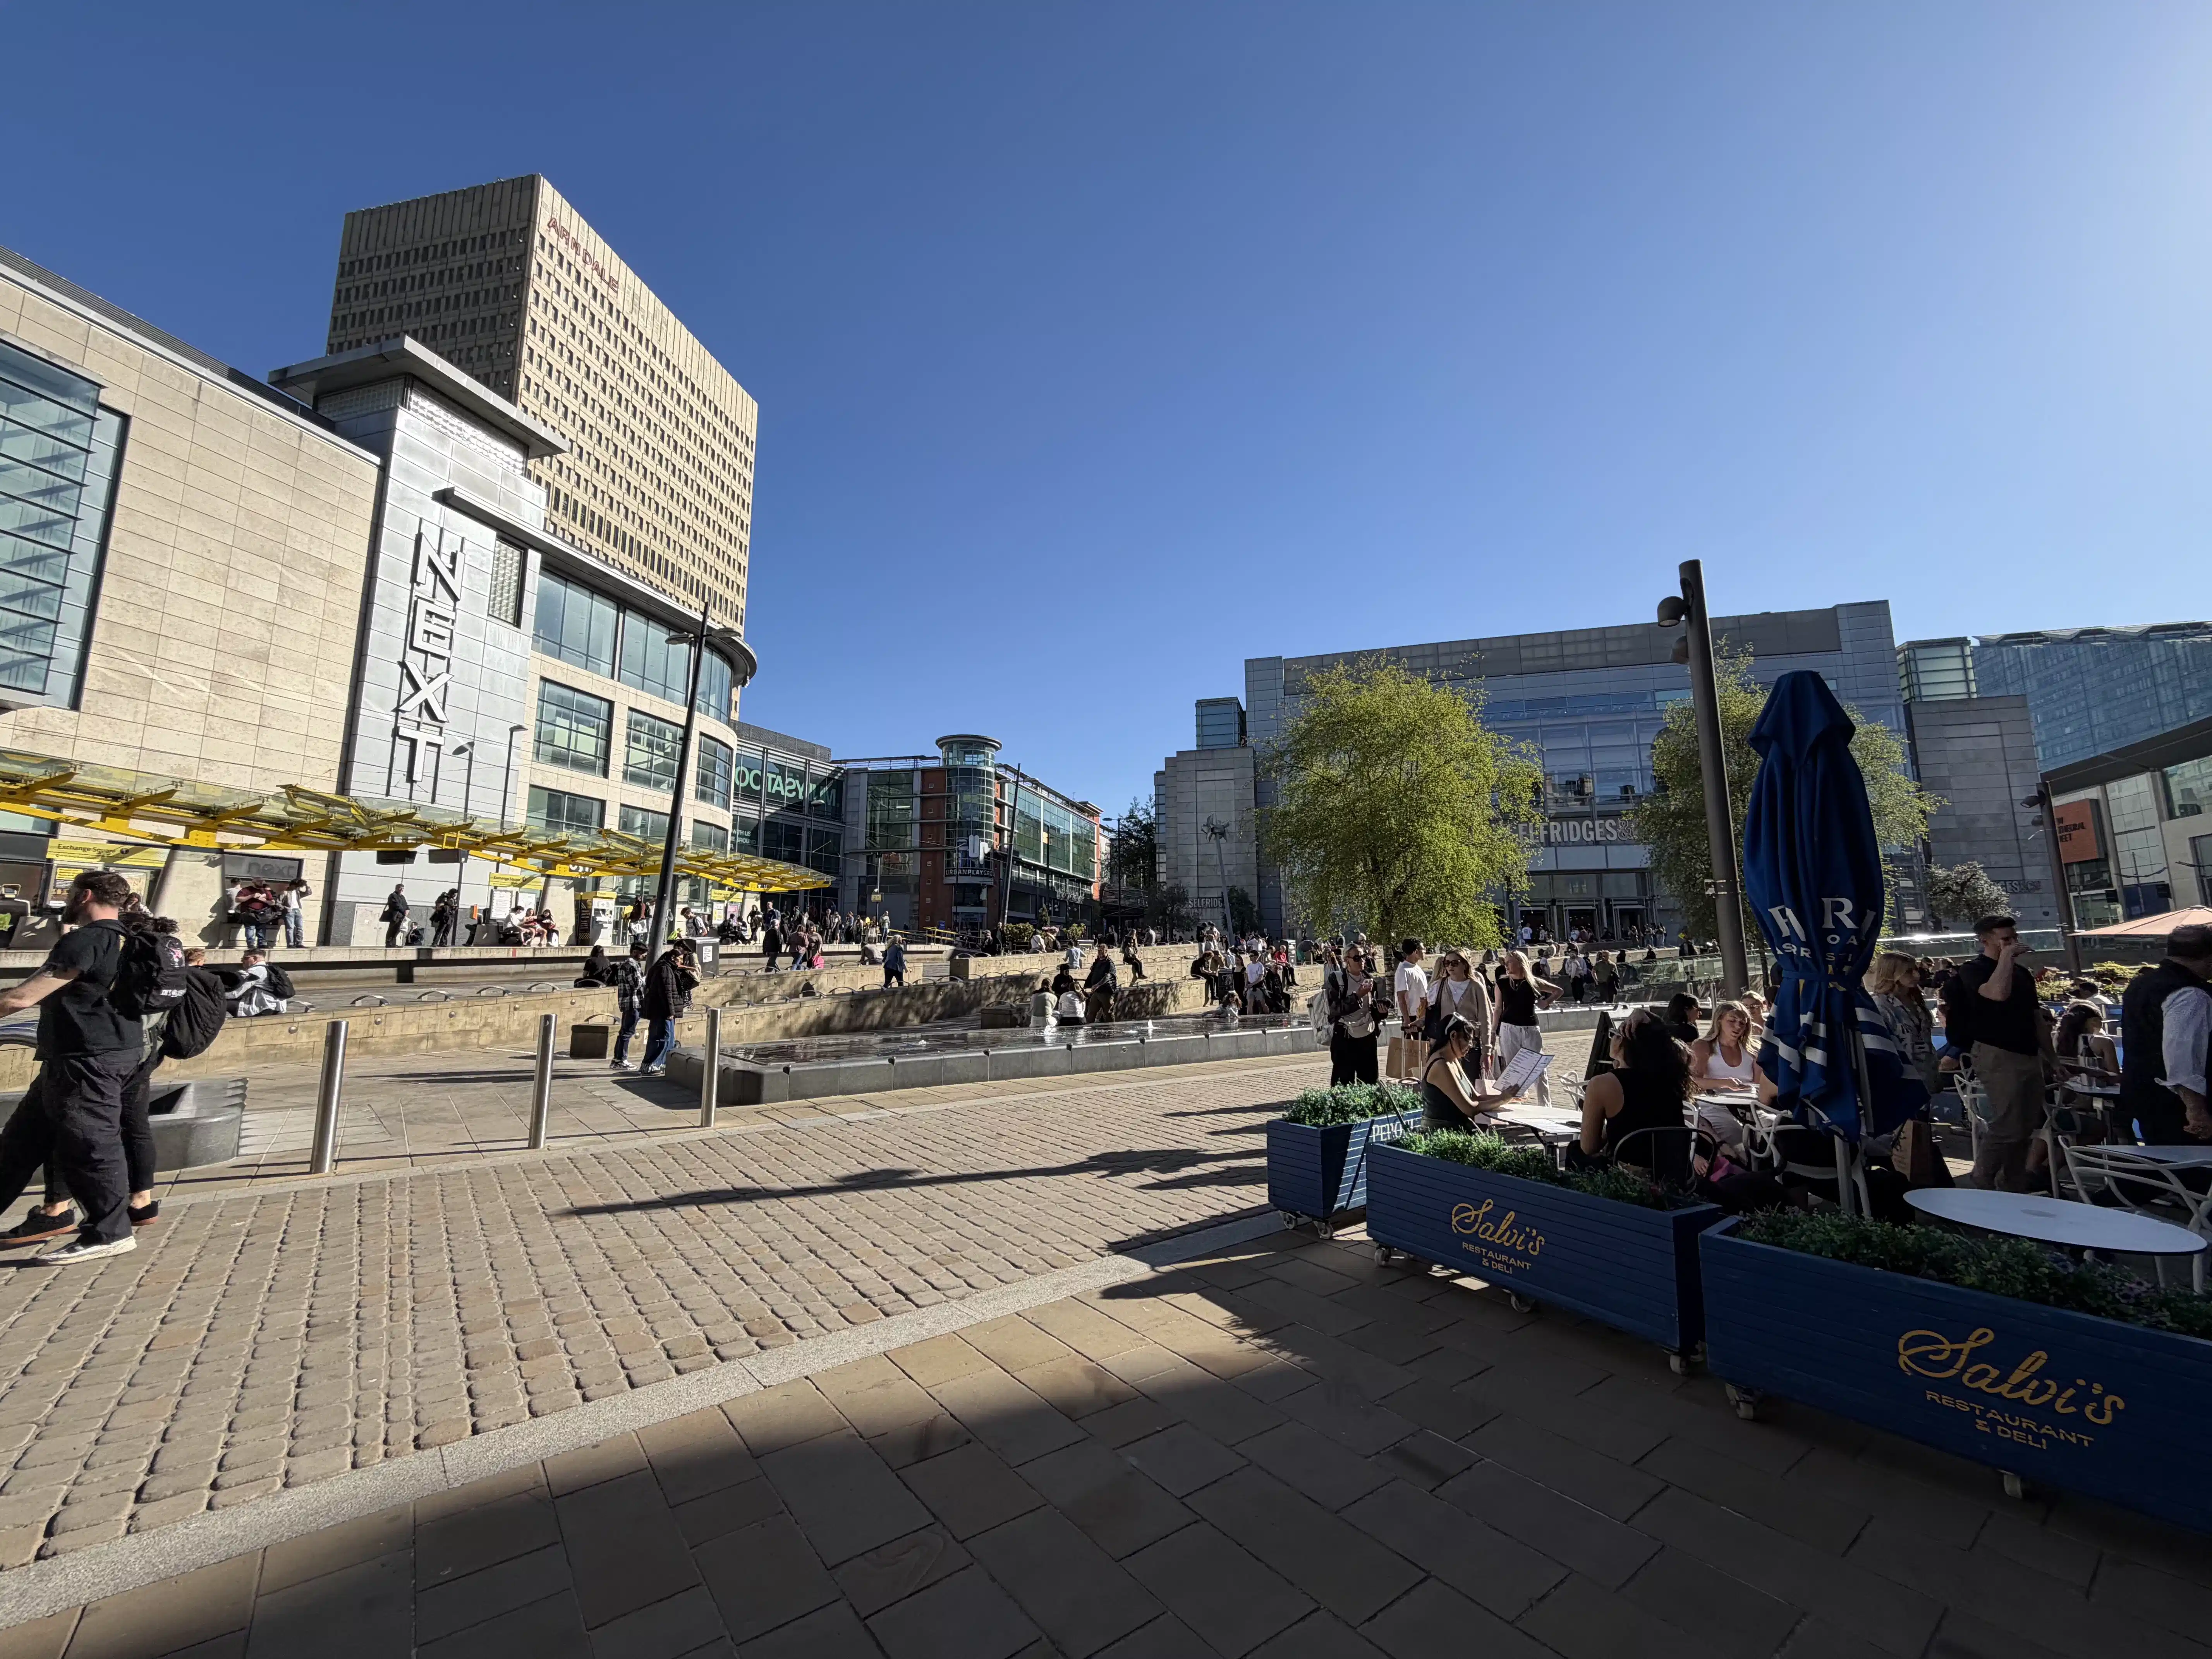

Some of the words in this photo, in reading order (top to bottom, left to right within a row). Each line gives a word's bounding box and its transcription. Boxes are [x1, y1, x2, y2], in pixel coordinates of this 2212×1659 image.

[547, 216, 619, 293] ARNDALE
[398, 532, 466, 782] NEXT
[58, 843, 91, 853] Exchange
[247, 861, 295, 879] next
[1451, 1198, 1545, 1255] Salvi's
[1462, 1242, 1532, 1270] RESTAURANT
[1482, 1258, 1489, 1267] &
[1491, 1261, 1513, 1274] DELI
[1898, 1327, 2125, 1425] Salvi's
[1925, 1389, 2094, 1448] RESTAURANT
[1975, 1419, 1991, 1433] &
[1997, 1426, 2047, 1451] DELI
